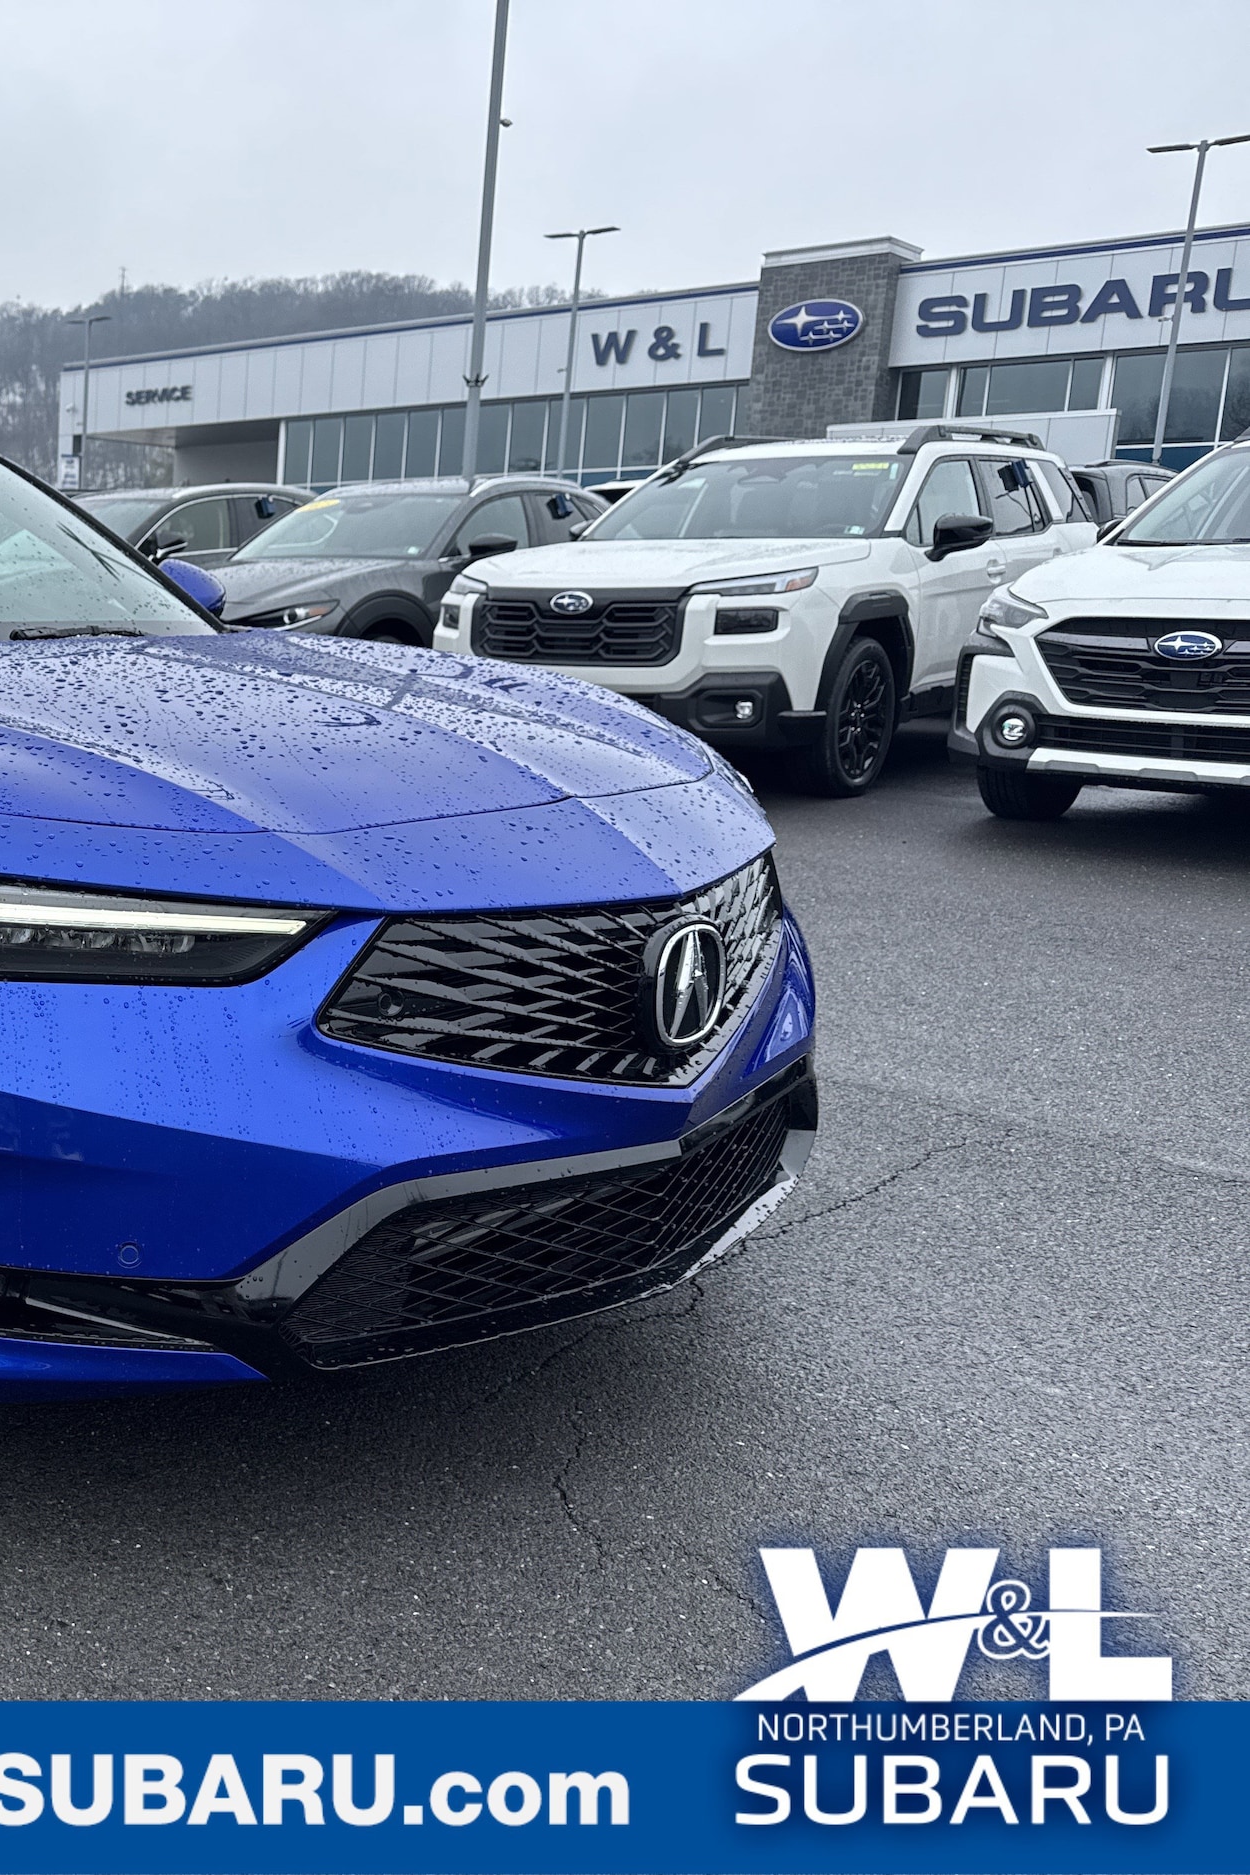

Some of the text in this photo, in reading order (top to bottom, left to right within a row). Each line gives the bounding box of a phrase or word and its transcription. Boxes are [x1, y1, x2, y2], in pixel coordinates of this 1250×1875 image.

[591, 322, 726, 367] W & L
[125, 385, 192, 406] SERVICE
